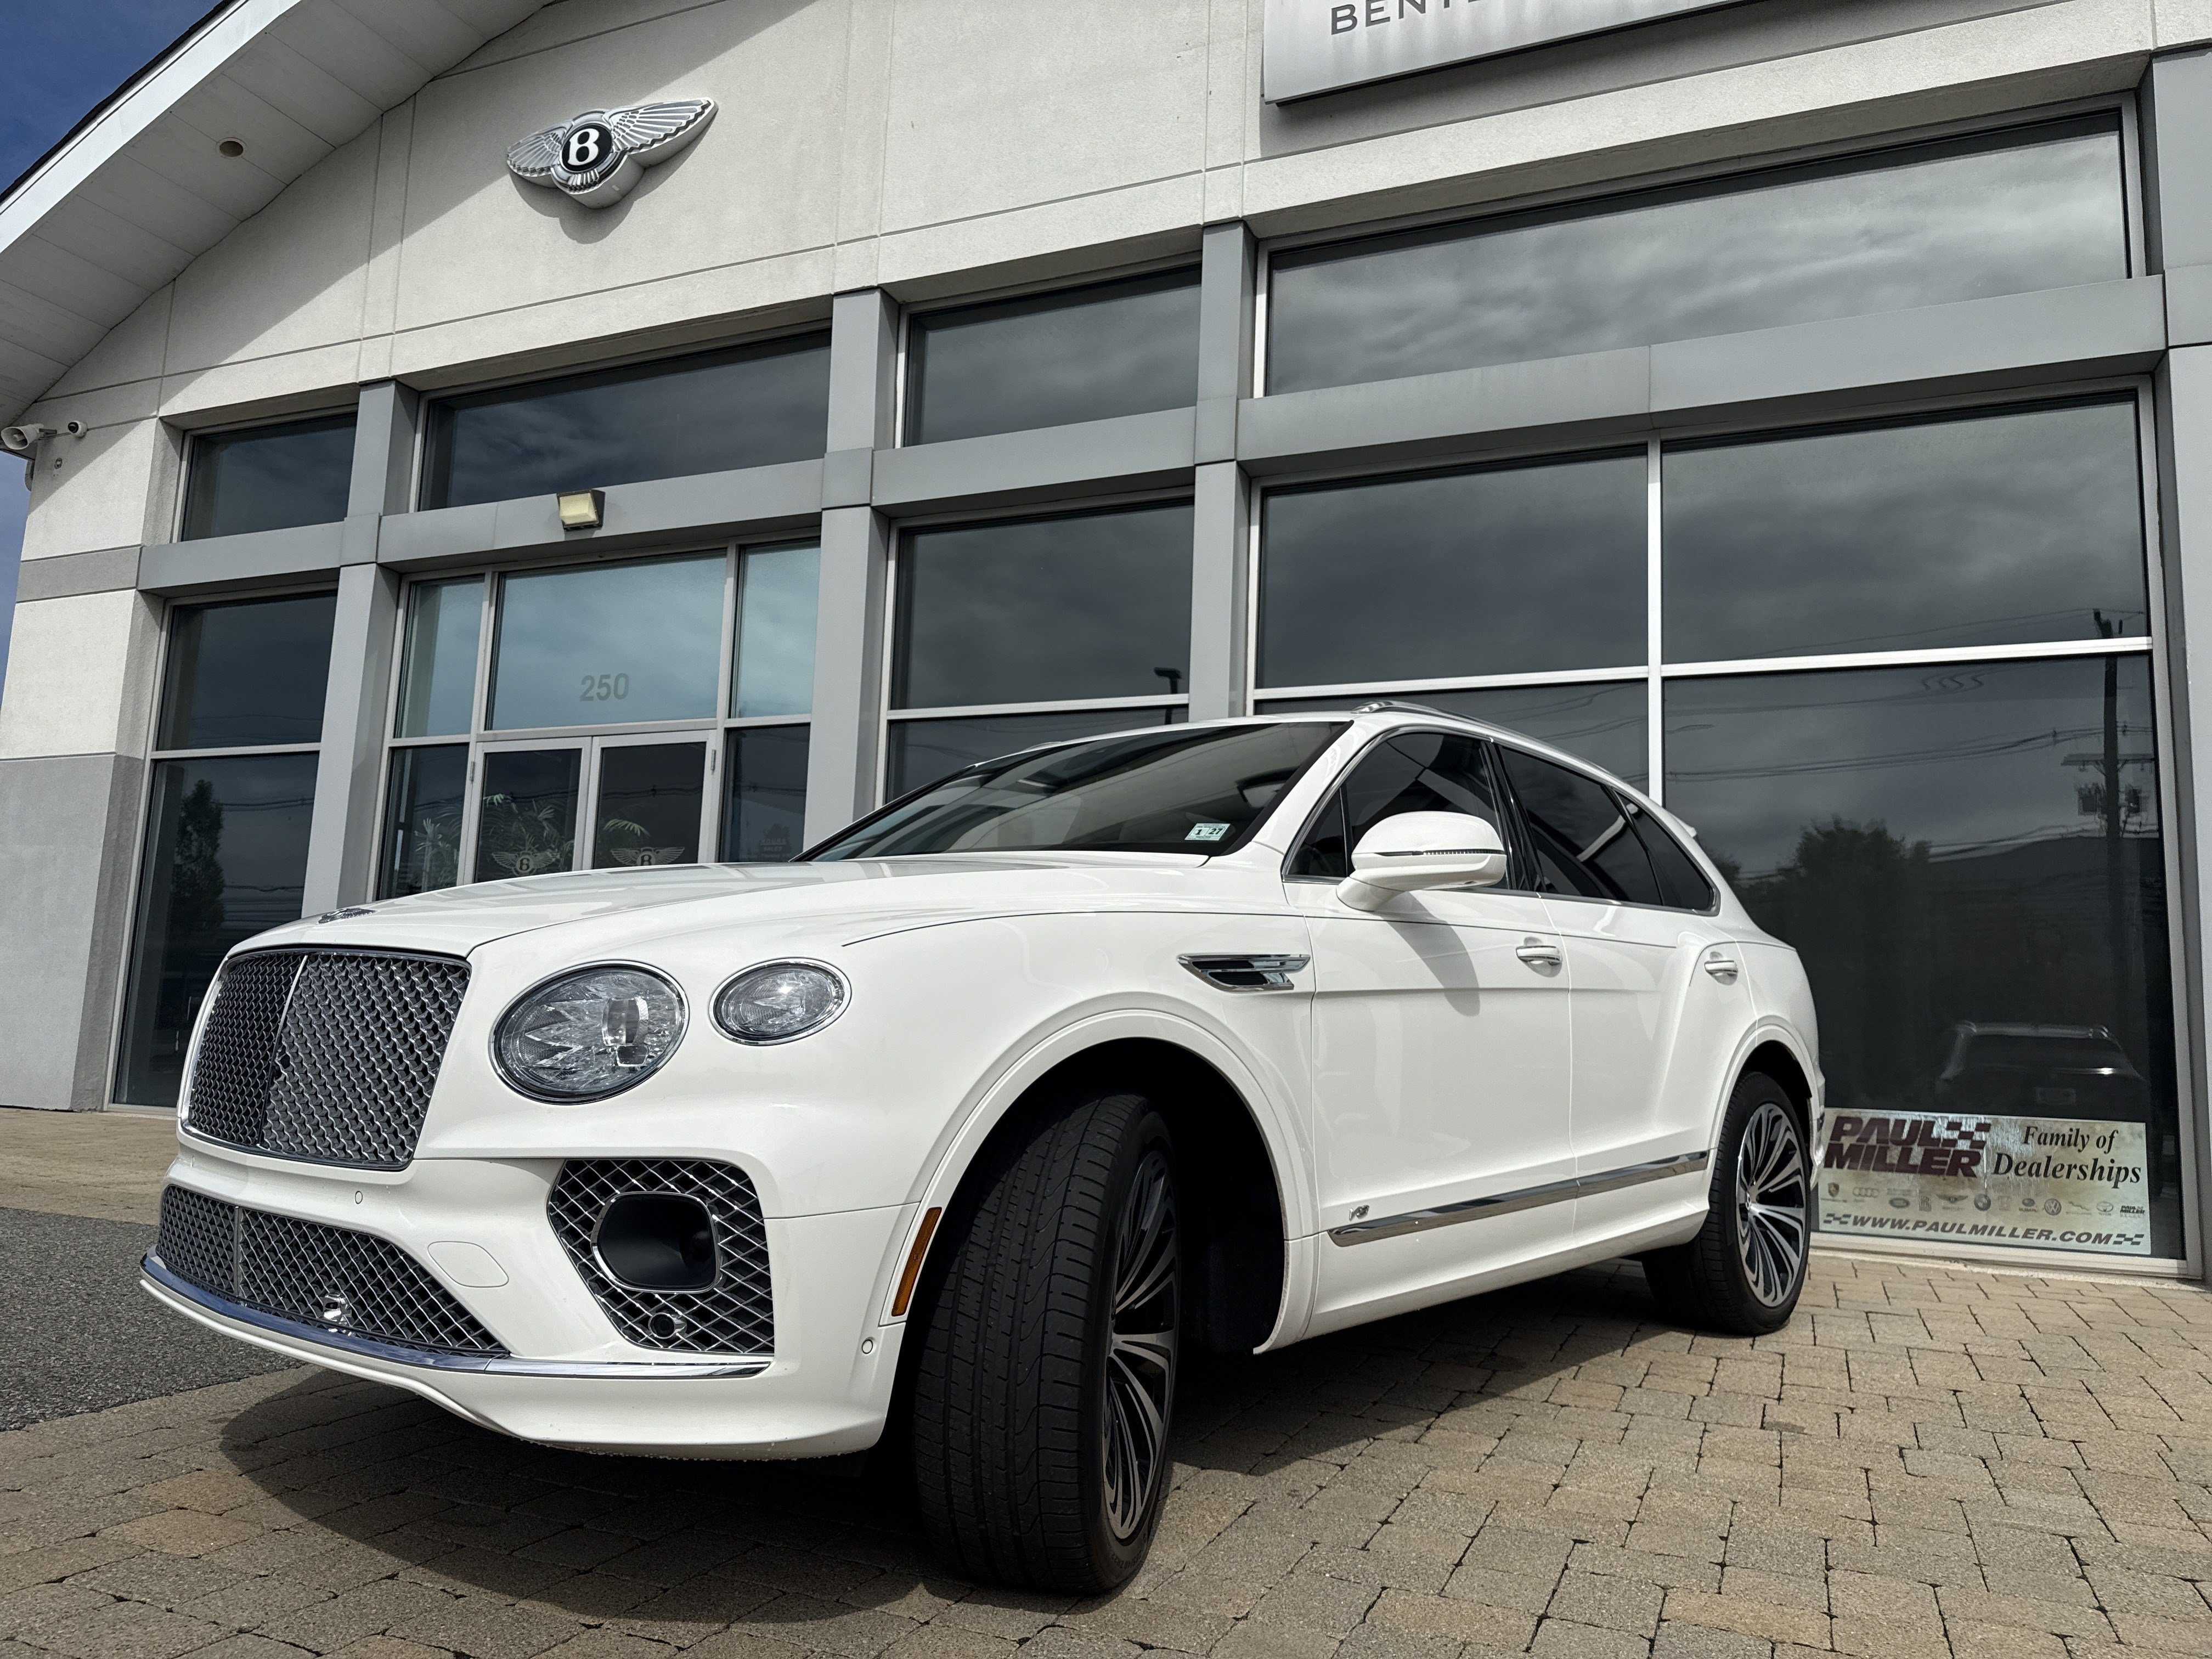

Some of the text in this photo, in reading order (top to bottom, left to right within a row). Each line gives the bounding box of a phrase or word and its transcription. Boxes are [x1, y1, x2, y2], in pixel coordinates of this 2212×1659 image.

[567, 128, 600, 166] B
[579, 673, 629, 702] 250
[1830, 1116, 1942, 1147] PAUL
[2023, 1125, 2119, 1154] Family of
[1824, 1143, 1982, 1178] MILLER
[1991, 1152, 2141, 1189] Dealerships
[1851, 1215, 2113, 1245] WWW.PAULMILLER.COM
